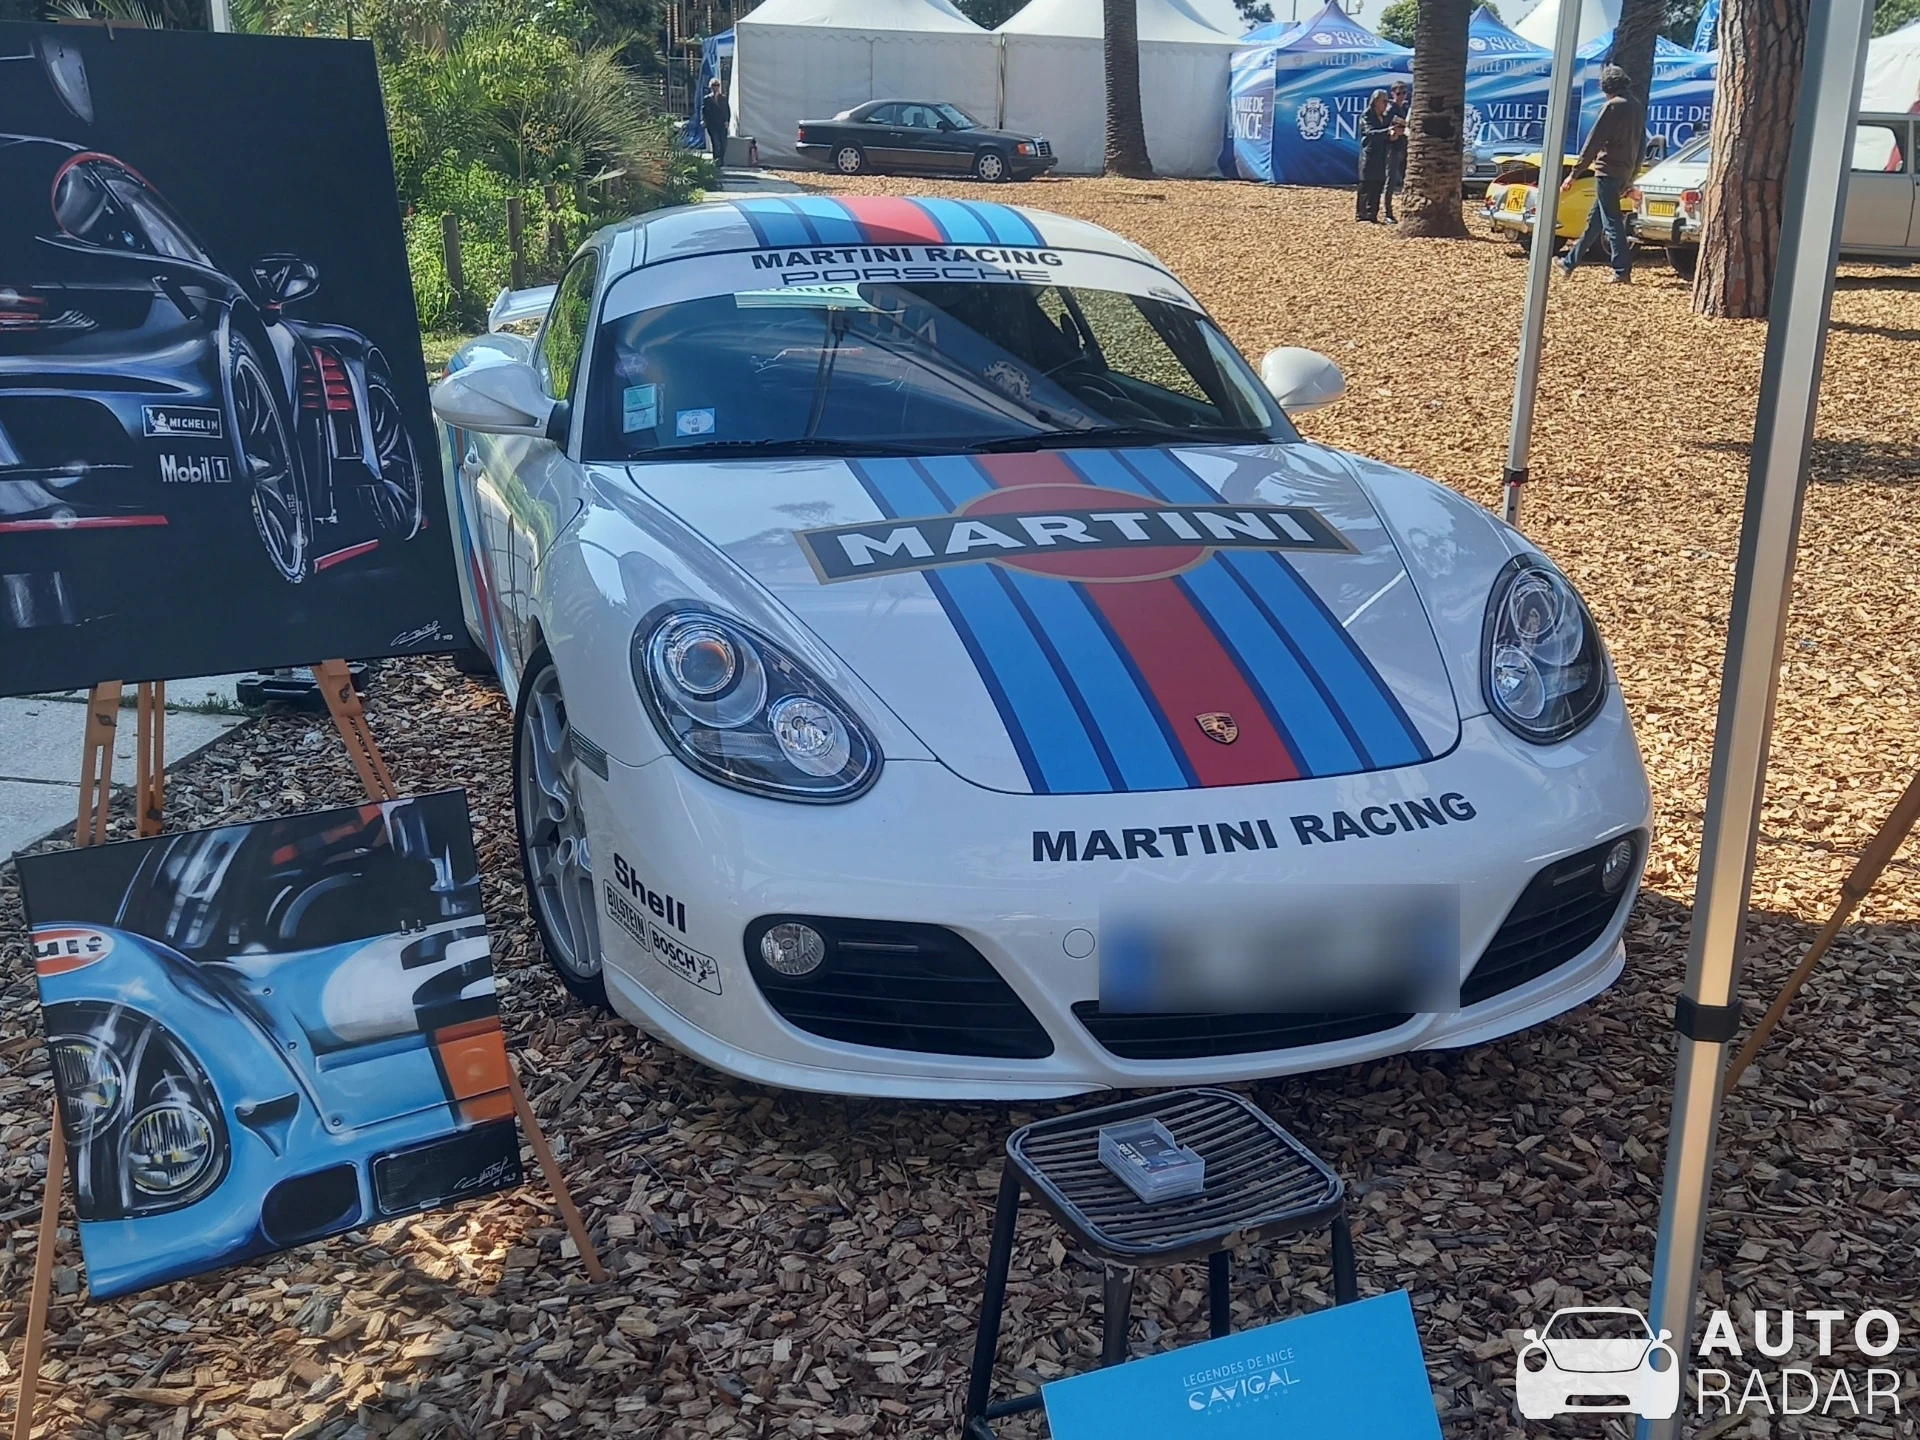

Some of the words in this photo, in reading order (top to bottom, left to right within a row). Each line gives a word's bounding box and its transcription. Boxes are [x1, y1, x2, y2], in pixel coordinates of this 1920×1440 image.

[1336, 35, 1384, 47] NICE
[1490, 40, 1537, 52] NICE
[1320, 53, 1346, 66] VILLE
[1474, 61, 1501, 72] VILLE
[1253, 97, 1264, 113] DE
[1332, 96, 1369, 113] VILL
[1486, 103, 1533, 120] VILLE
[1537, 104, 1548, 120] D
[1647, 105, 1684, 121] ILLE
[1688, 105, 1711, 122] DE
[1234, 113, 1263, 140] NICE
[751, 247, 913, 270] MARTINI
[926, 247, 1063, 267] RACING
[781, 267, 1052, 286] PORSCHE
[169, 417, 218, 430] MICHELIN
[159, 454, 212, 483] Mobil
[835, 511, 1316, 568] MARTINI
[1032, 819, 1278, 862] MARTINI
[1289, 791, 1477, 846] RACING
[614, 852, 687, 934] Shell
[607, 885, 646, 938] BILSTEIN
[34, 935, 104, 958] ulf
[652, 929, 697, 973] BOSCH
[1183, 1361, 1244, 1387] LEGENDES
[1247, 1356, 1263, 1370] DE
[1266, 1347, 1295, 1364] NICE
[1188, 1367, 1300, 1411] CAVIGAL
